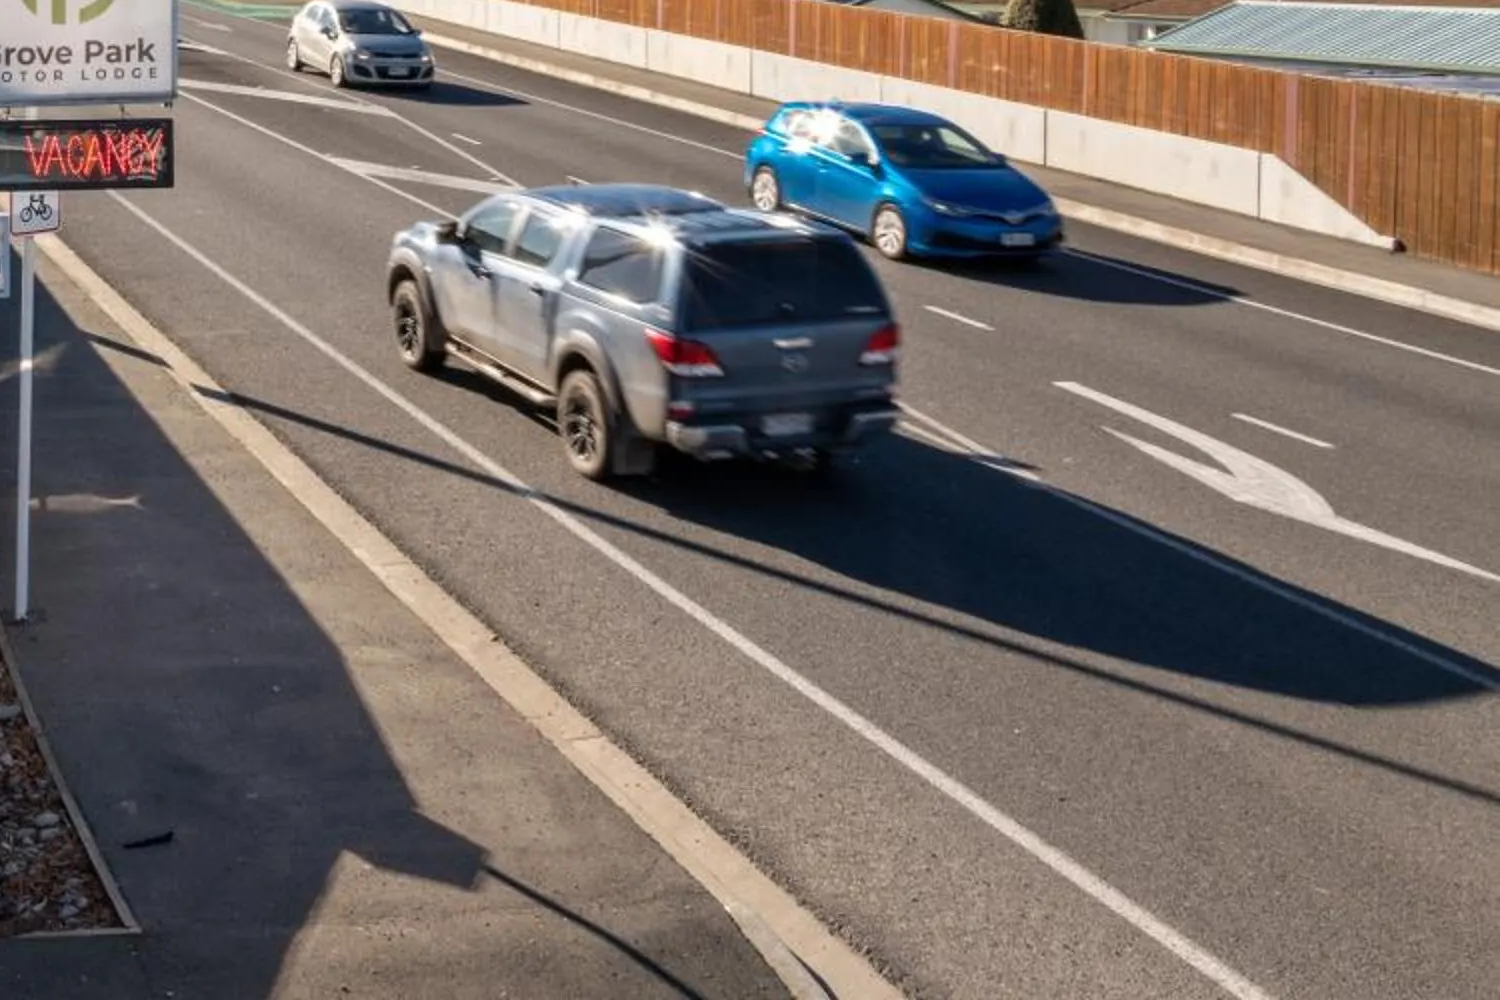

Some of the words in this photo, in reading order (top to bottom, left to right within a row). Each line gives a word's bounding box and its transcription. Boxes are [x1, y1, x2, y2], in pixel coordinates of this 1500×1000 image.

[85, 37, 156, 63] Park
[81, 67, 158, 81] LODGE
[24, 128, 165, 180] VACANCY
